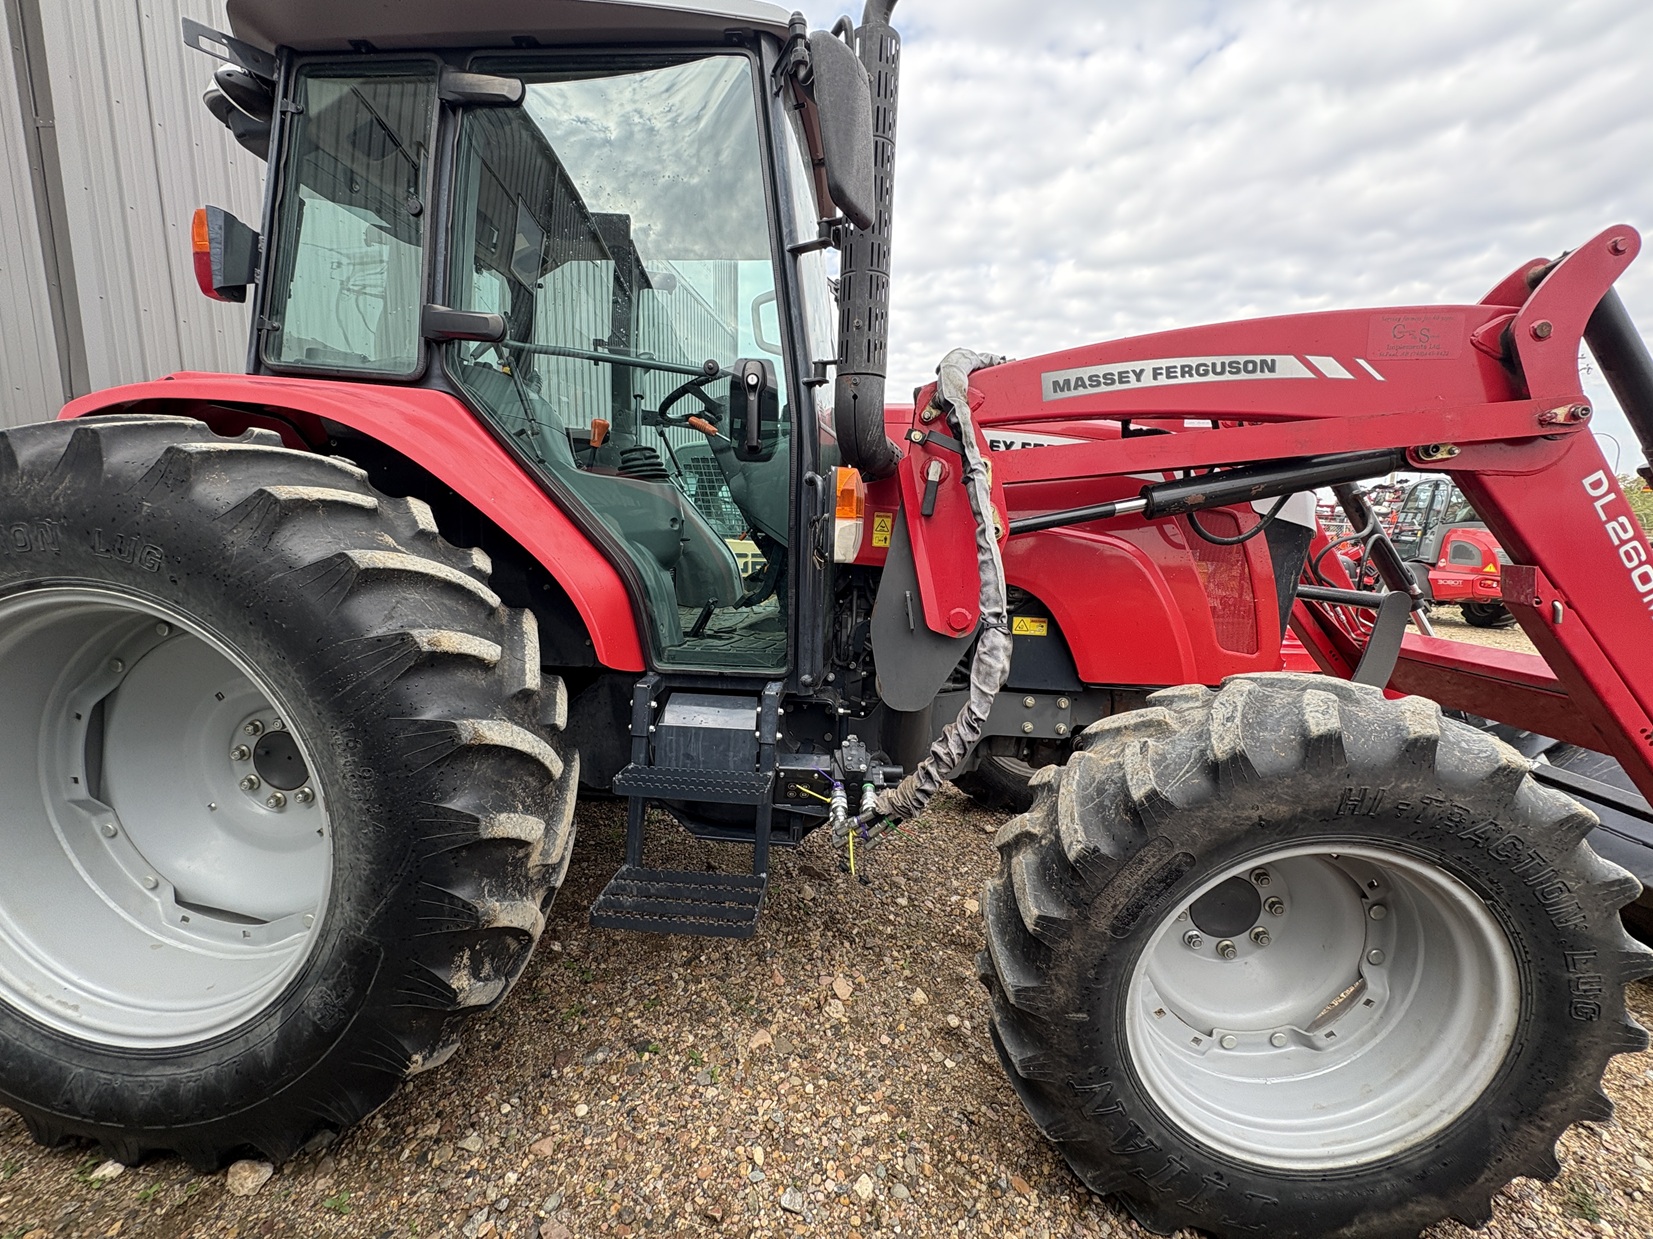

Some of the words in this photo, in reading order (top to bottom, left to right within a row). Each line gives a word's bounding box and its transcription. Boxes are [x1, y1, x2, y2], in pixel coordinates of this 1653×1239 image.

[1052, 368, 1146, 394] MASSEY
[1152, 358, 1277, 381] FERGUSON
[93, 527, 164, 573] LUG
[1581, 469, 1653, 620] DL260
[1562, 949, 1602, 1022] LUG
[1066, 1074, 1279, 1231] TITAN
